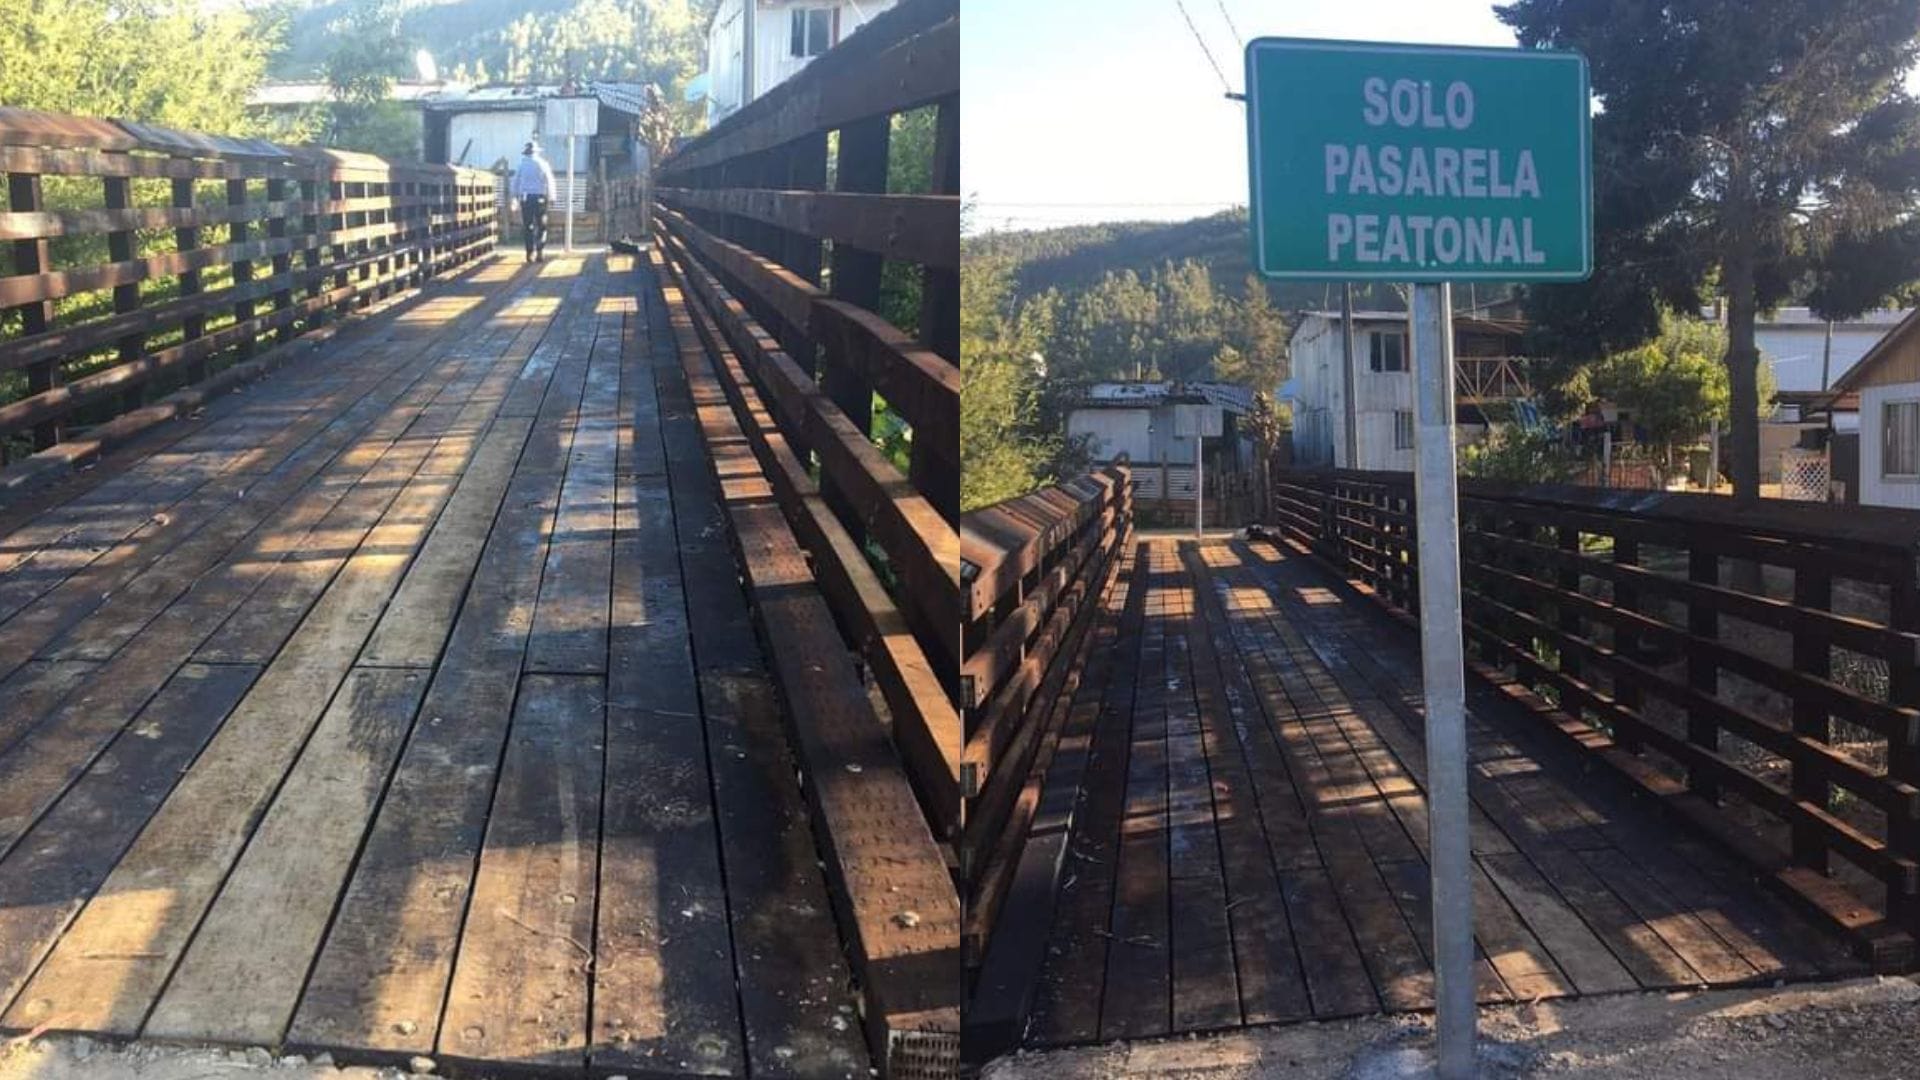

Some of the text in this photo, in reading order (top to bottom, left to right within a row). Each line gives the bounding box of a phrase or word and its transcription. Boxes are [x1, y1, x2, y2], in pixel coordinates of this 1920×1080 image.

[1363, 77, 1475, 130] SOLO
[1324, 144, 1542, 198] PASARELA
[1327, 213, 1545, 264] PEATONAL
